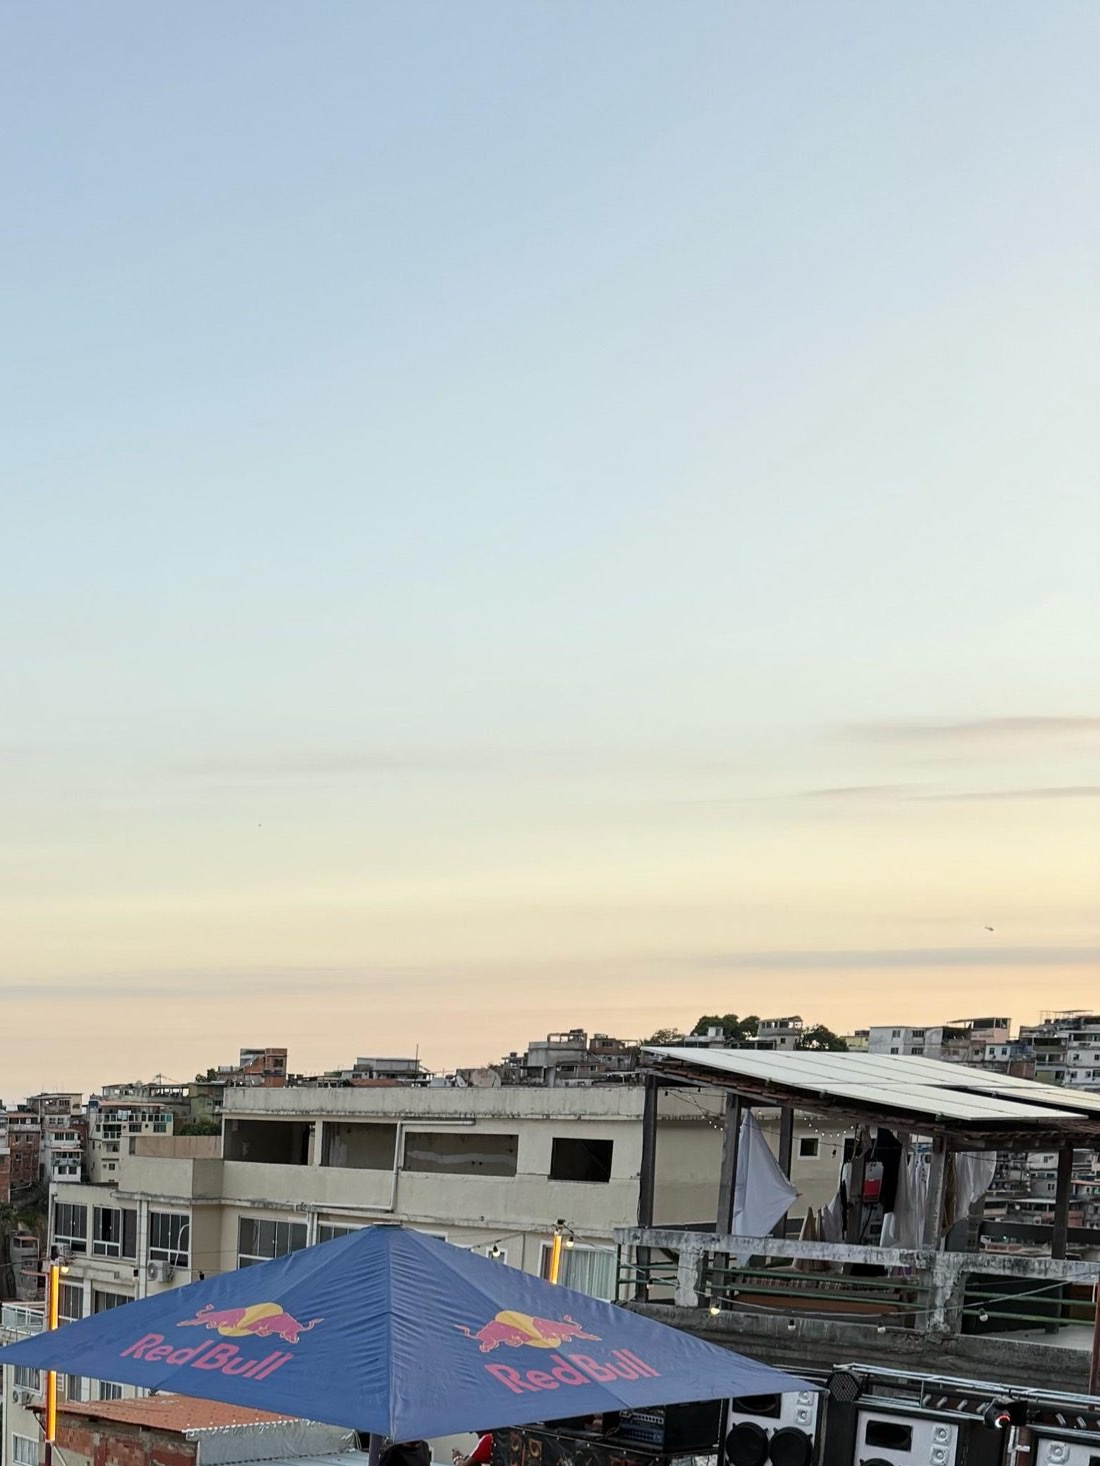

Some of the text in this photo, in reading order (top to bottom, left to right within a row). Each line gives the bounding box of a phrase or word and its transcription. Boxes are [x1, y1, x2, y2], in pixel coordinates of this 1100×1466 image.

[120, 1333, 294, 1381] Red Bull
[484, 1349, 662, 1394] Red Bull
